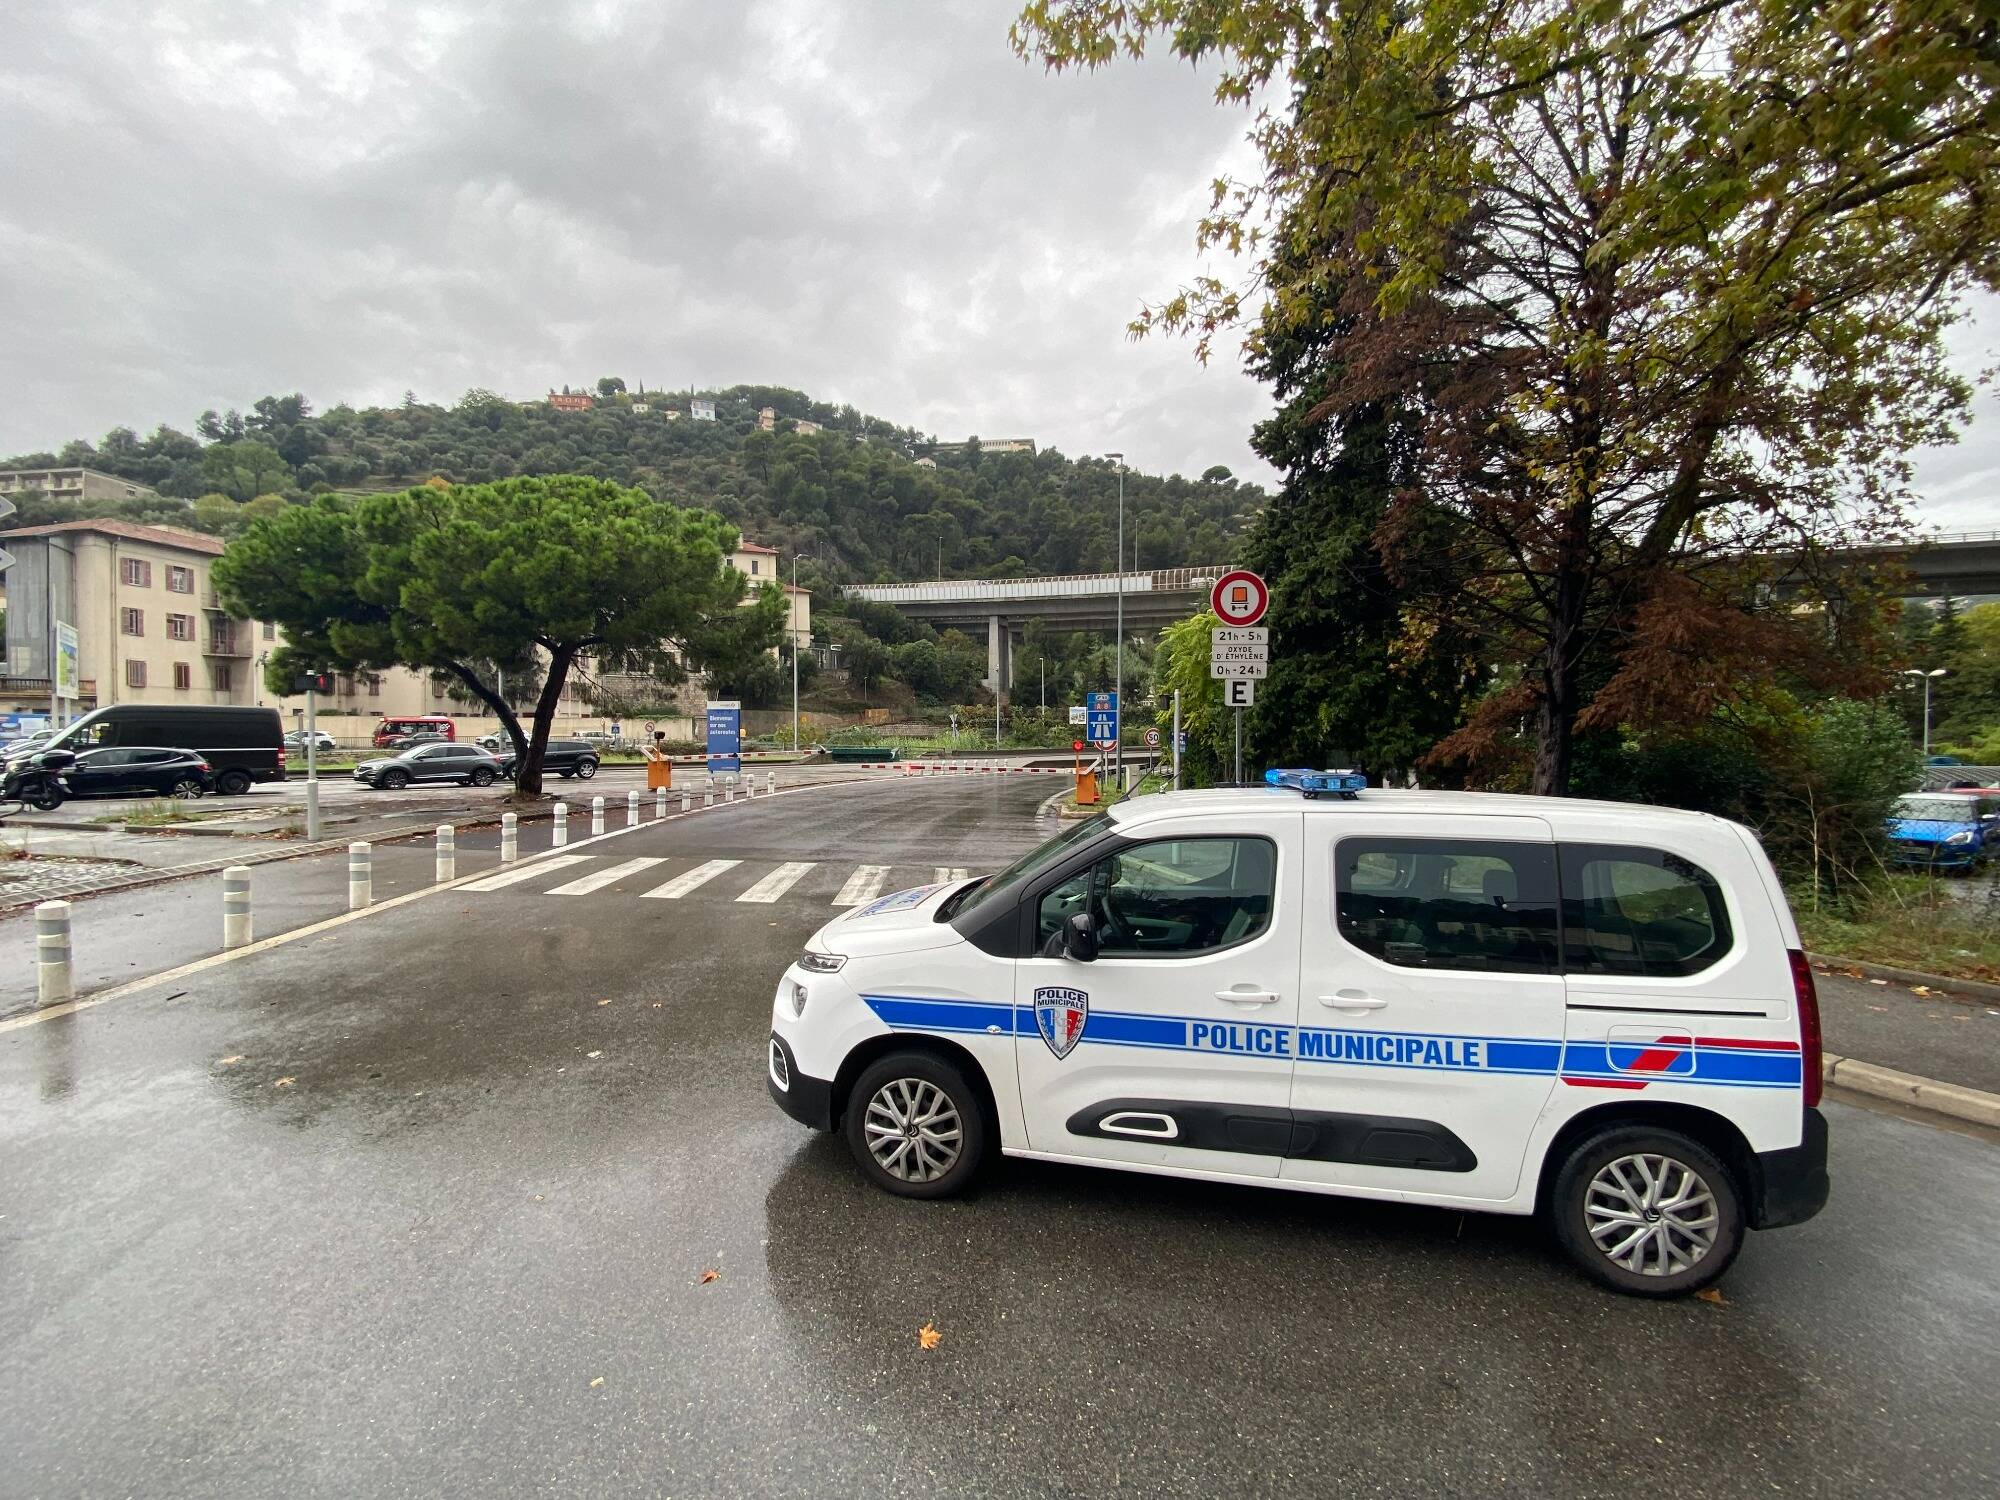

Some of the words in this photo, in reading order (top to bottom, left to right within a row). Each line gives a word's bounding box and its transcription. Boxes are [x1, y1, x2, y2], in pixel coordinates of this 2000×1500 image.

[1232, 681, 1247, 704] E
[1148, 734, 1159, 742] 50
[1037, 989, 1085, 1003] POLICE
[1037, 999, 1085, 1010] MUNICIPALE
[1192, 1023, 1290, 1054] POLICE
[1298, 1031, 1480, 1067] MUNICIPALE
